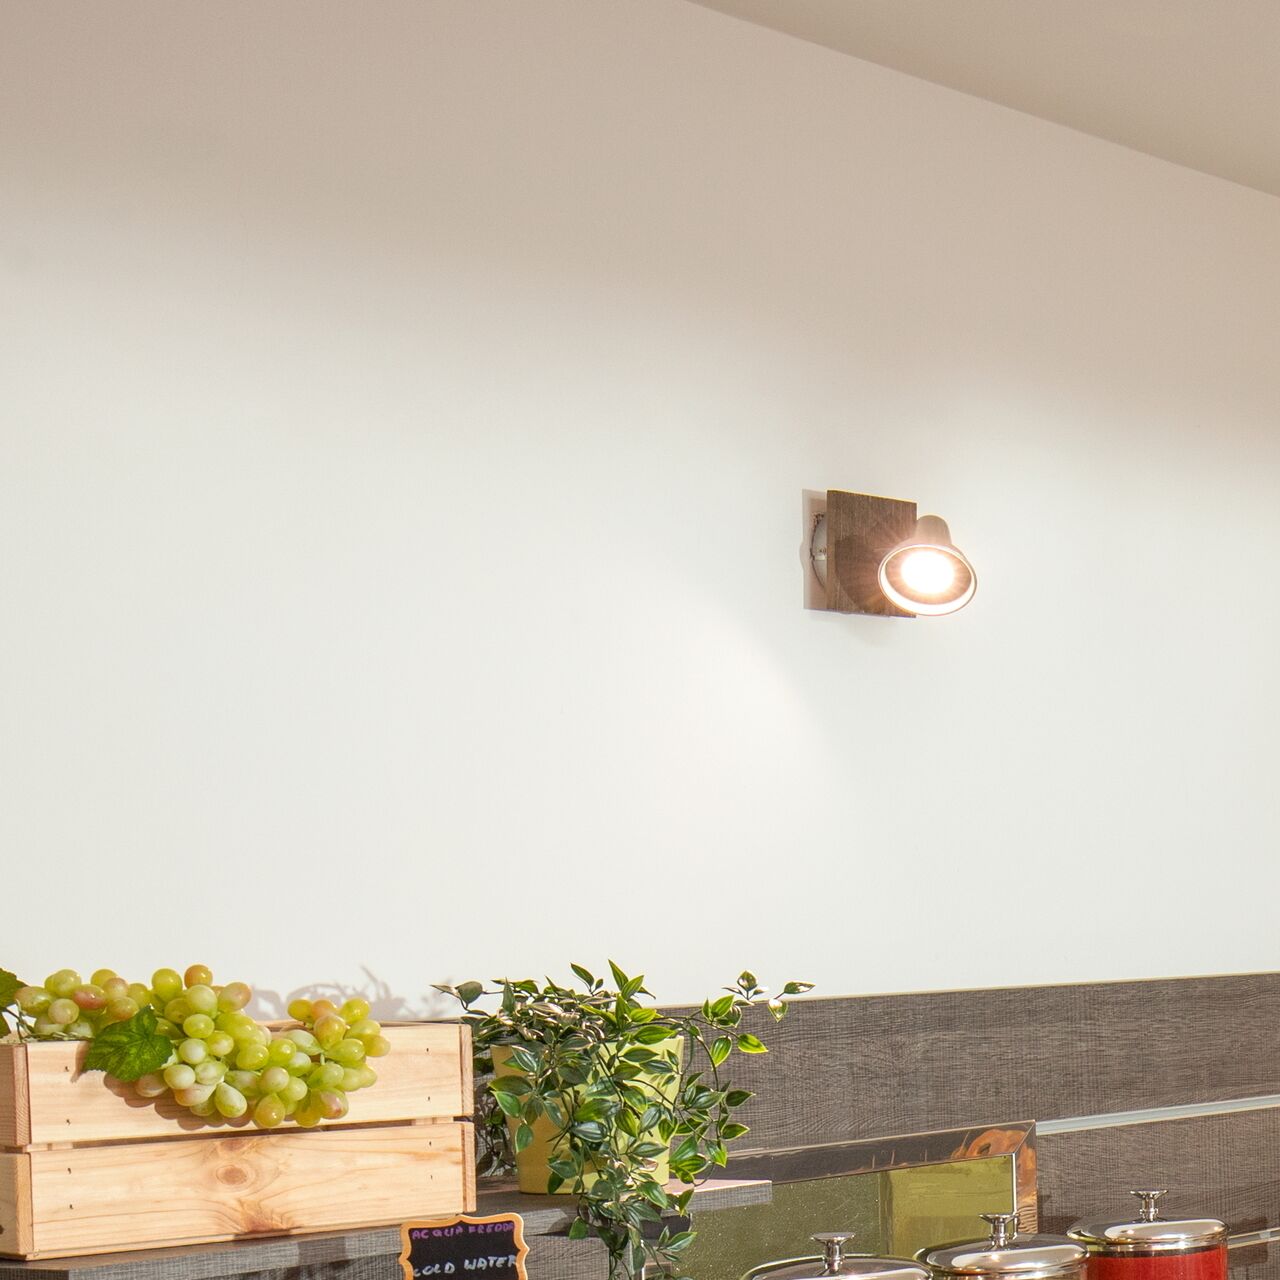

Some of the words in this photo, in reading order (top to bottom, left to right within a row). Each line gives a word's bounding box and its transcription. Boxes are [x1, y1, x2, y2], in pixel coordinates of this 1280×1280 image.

[412, 1225, 463, 1241] ACQUA
[413, 1262, 456, 1278] COLD
[464, 1255, 517, 1271] WATER
